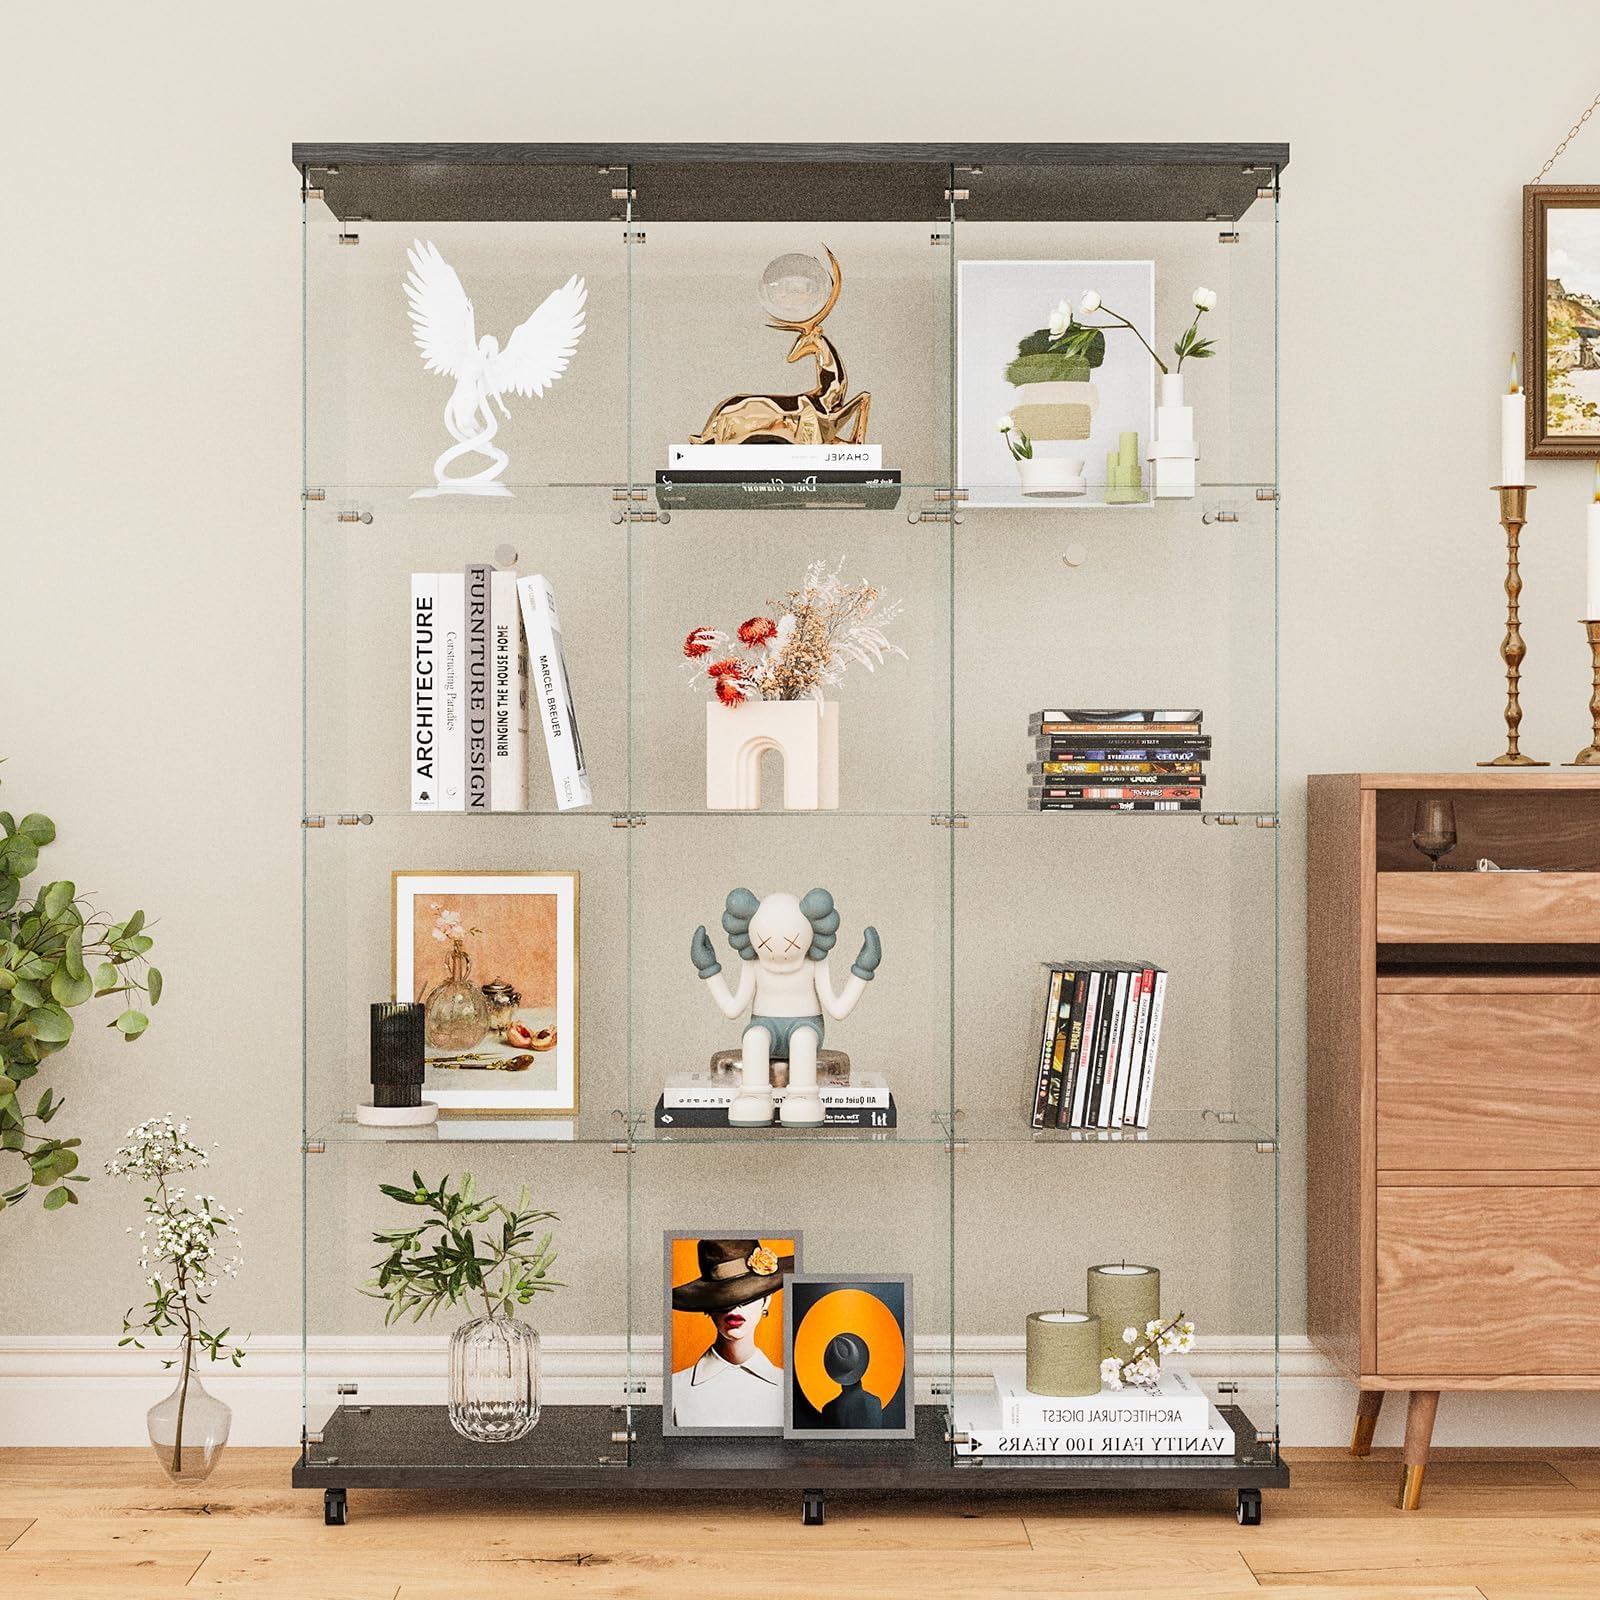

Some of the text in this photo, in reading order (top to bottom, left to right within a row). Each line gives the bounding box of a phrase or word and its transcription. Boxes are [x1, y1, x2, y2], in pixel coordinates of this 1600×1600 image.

[416, 597, 433, 779] ARCHITECTURE
[445, 631, 457, 691] Constructing
[470, 568, 485, 809] FURNITURE DESIGN
[497, 625, 509, 757] BRINGING THE HOUSE HOME
[539, 655, 562, 738] MARCEL BREUER
